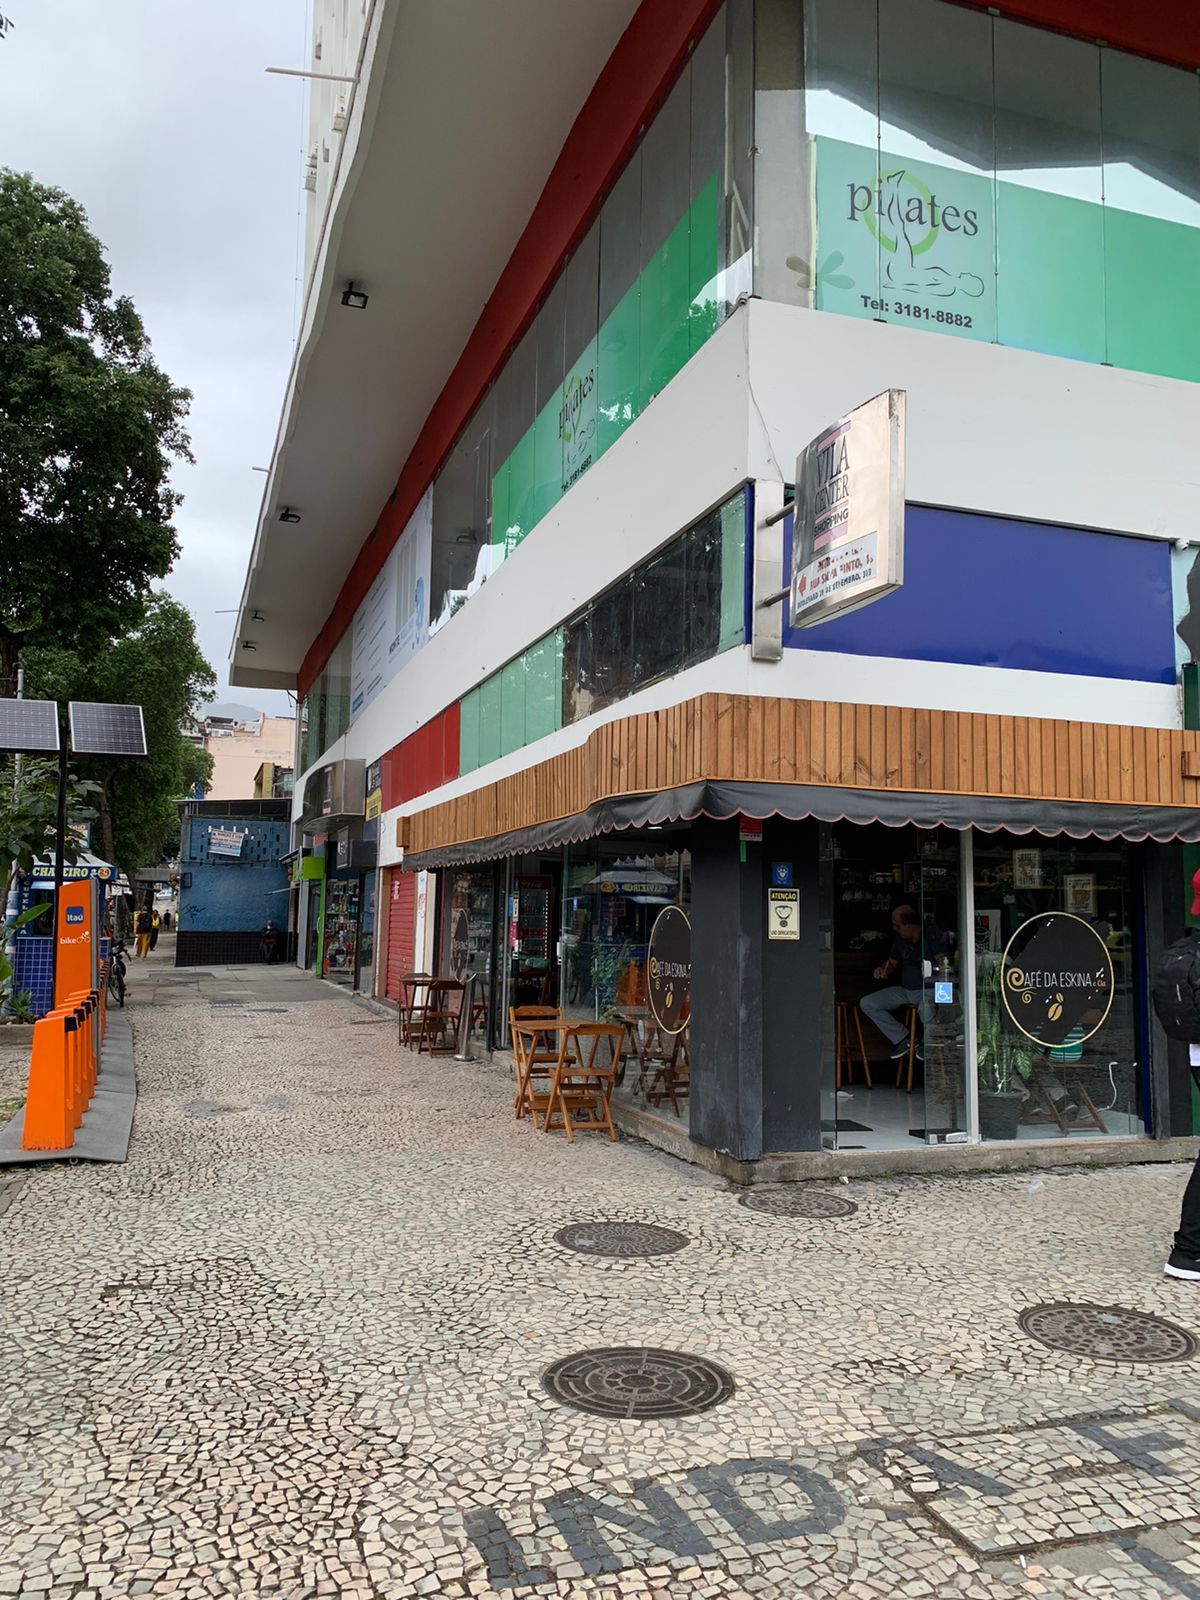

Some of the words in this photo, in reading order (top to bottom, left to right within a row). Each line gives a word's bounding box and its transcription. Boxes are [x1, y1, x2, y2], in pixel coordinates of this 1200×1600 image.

[861, 295, 889, 313] Tel:
[894, 302, 972, 328] 3181-8882
[816, 434, 850, 488] VILA
[814, 473, 850, 511] CENTER
[813, 508, 849, 537] SHOPPING
[32, 867, 89, 877] CHAEIRO
[771, 892, 797, 901] ATENÇÃO
[67, 913, 83, 922] Itaú
[60, 936, 76, 945] bike
[1044, 972, 1057, 988] DA
[1060, 972, 1092, 988] ESKINA
